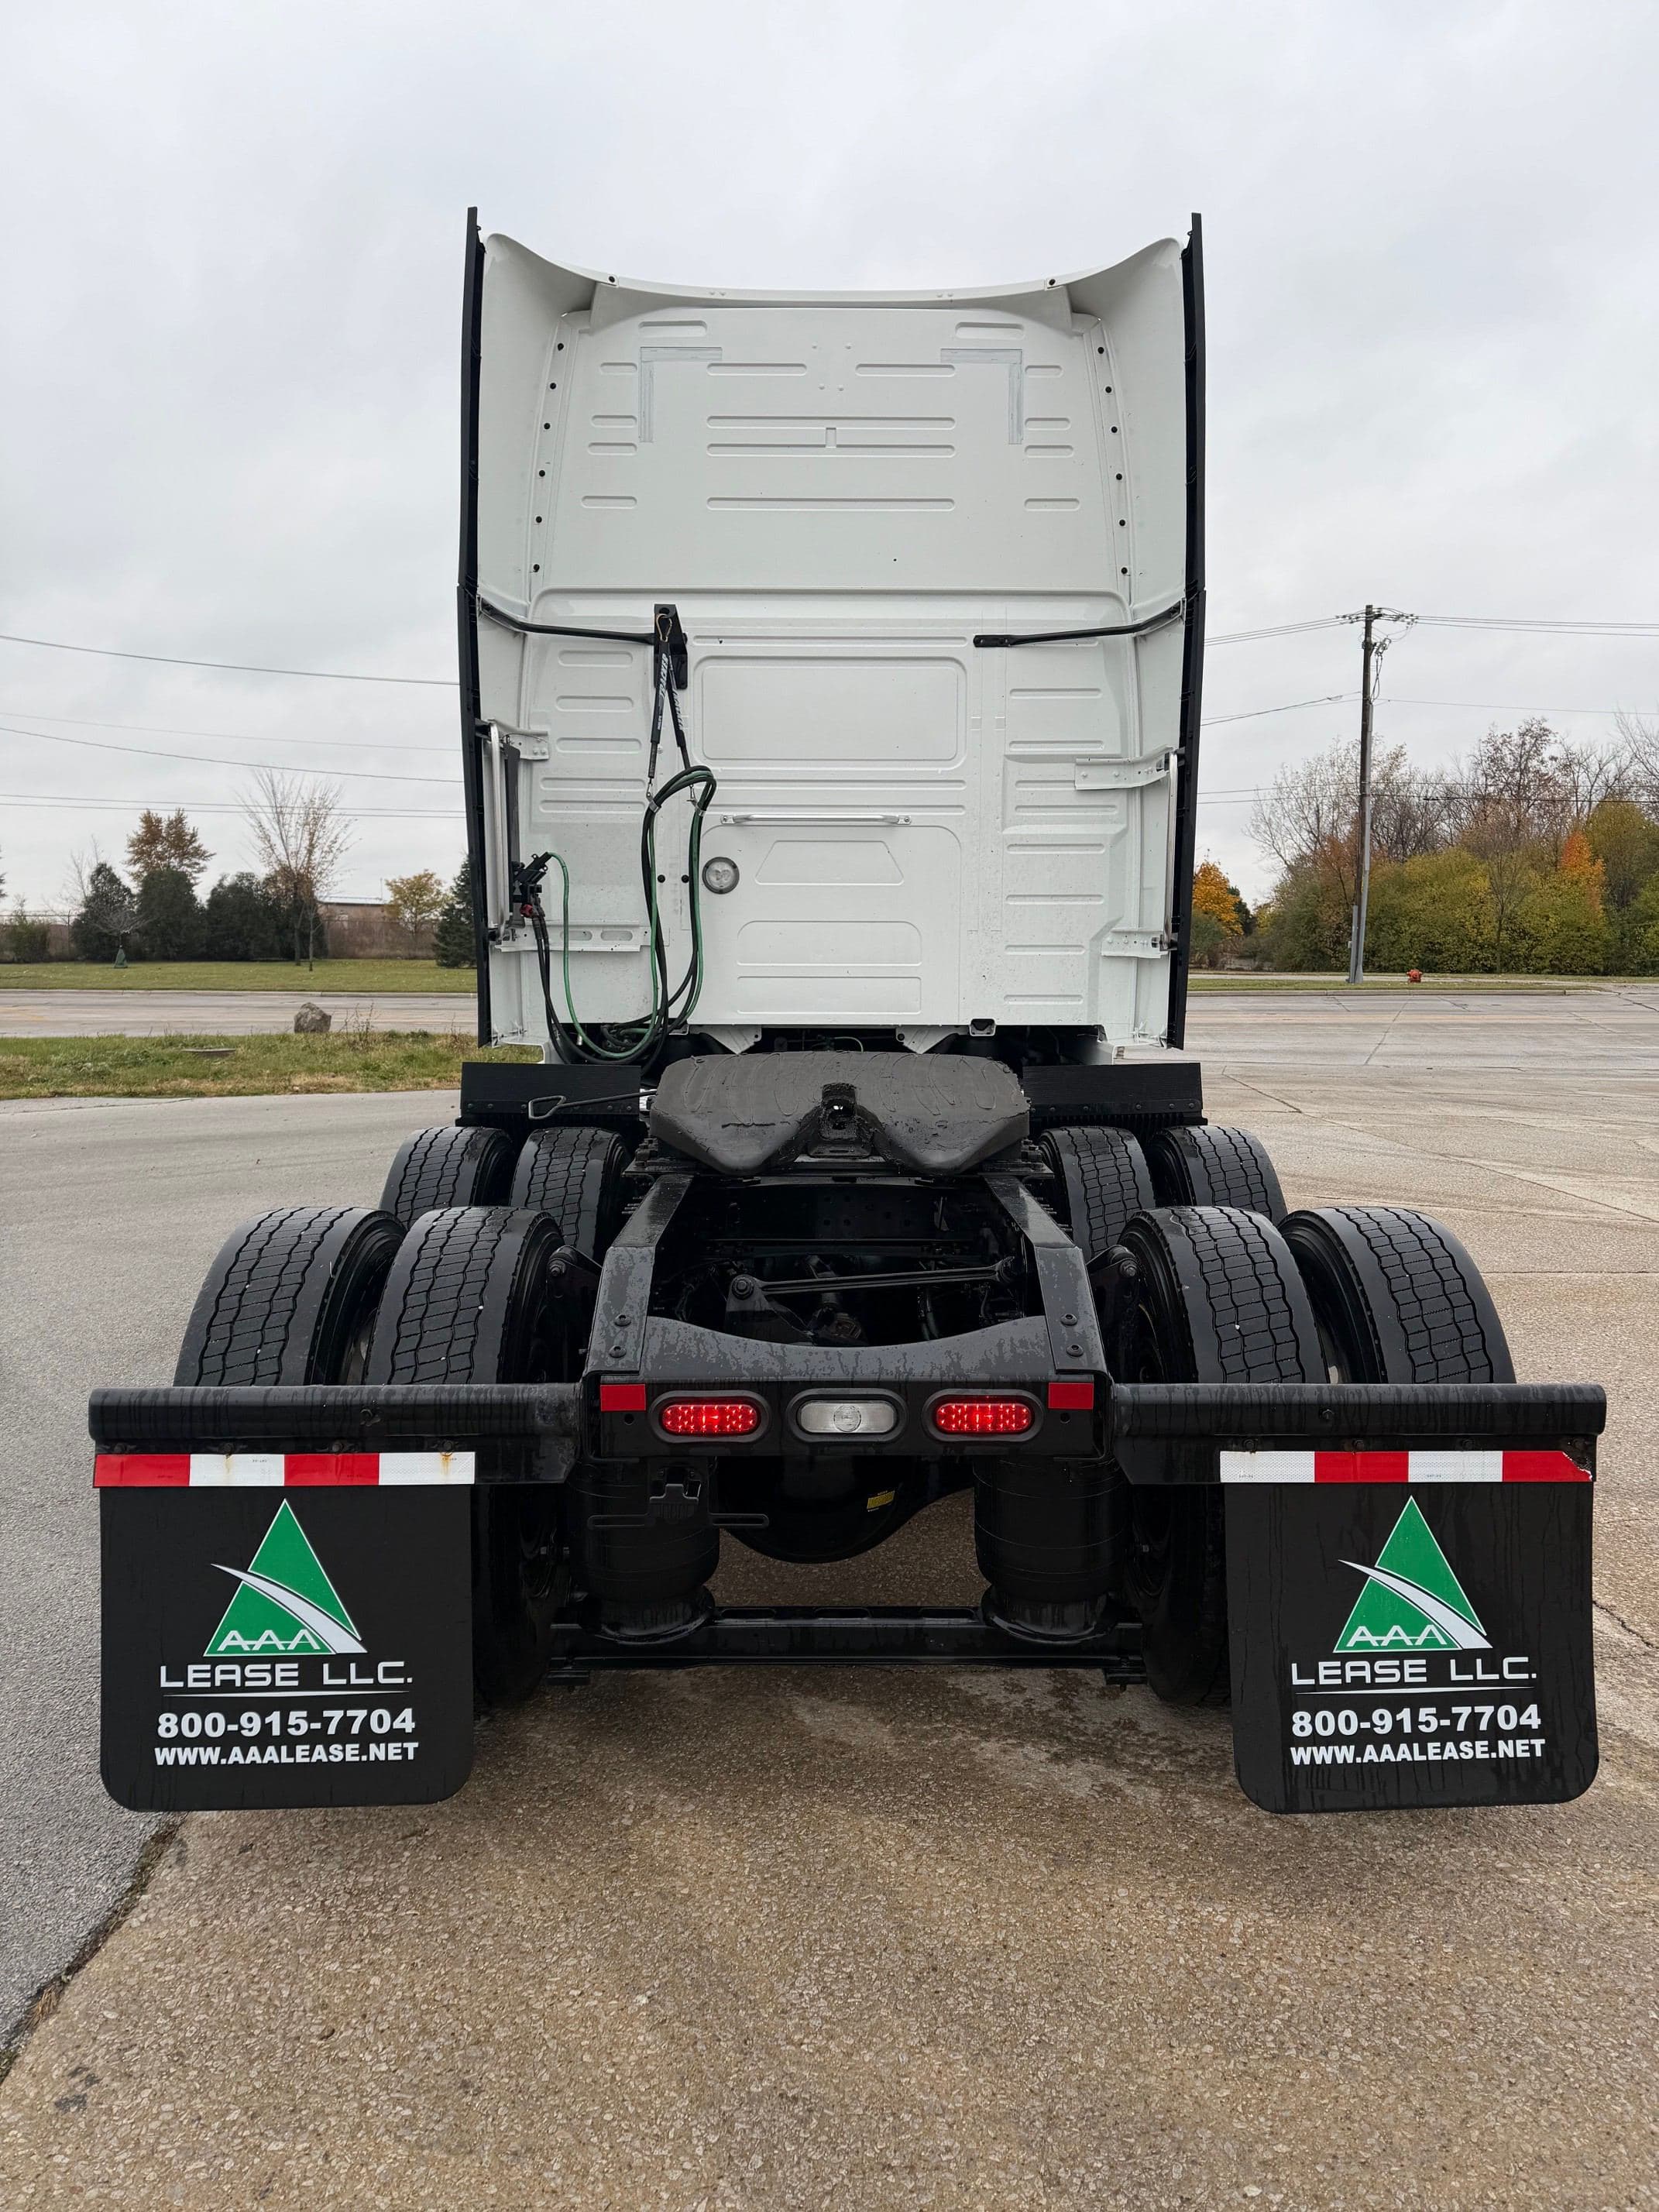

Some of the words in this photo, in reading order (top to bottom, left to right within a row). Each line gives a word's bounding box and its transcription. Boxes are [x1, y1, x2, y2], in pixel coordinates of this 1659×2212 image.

[216, 1629, 321, 1651] AAA
[1345, 1624, 1448, 1647] AAA
[160, 1662, 300, 1688] LEASE
[322, 1661, 414, 1685] LLC.
[1291, 1659, 1427, 1685] LEASE
[1449, 1656, 1537, 1681] LLC.
[156, 1708, 417, 1739] 800-915-7704
[1291, 1704, 1542, 1738] 800-915-7704
[154, 1742, 419, 1766] WWW.AAALEASE.NET
[1290, 1739, 1547, 1766] WWW.AAALEASE.NET
